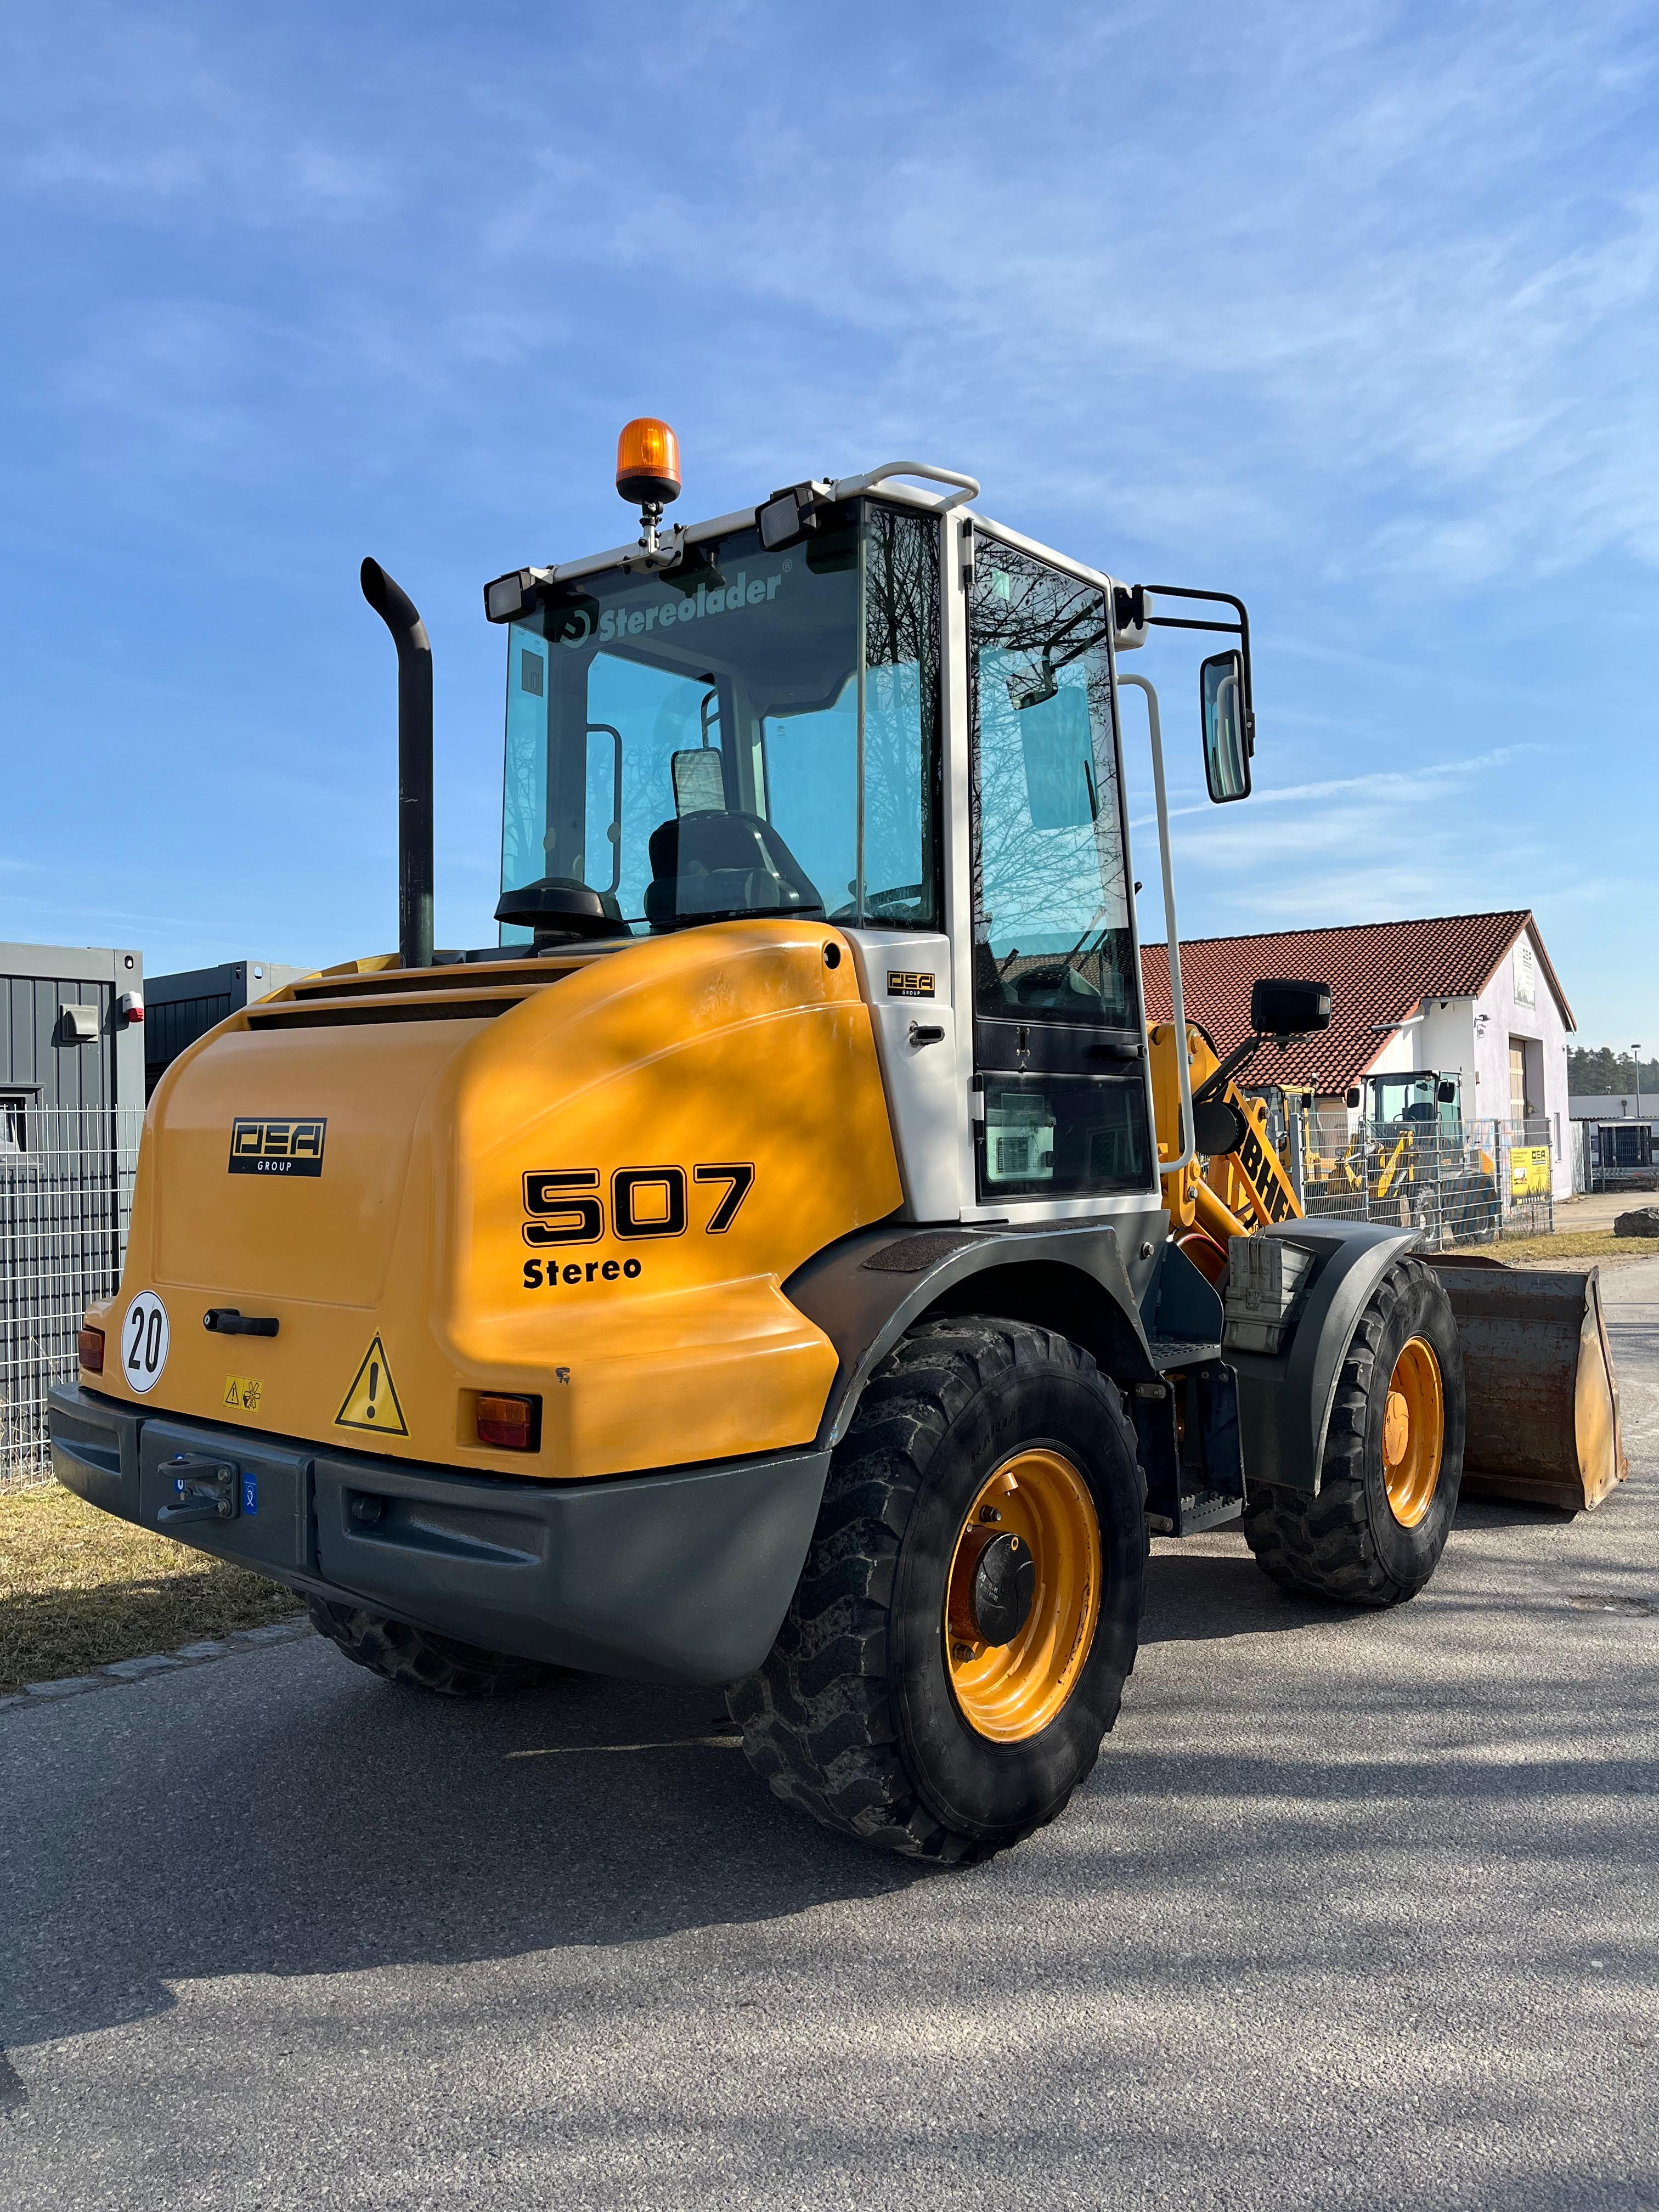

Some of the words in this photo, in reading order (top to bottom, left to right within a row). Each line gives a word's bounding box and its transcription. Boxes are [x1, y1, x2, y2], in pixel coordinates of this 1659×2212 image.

[257, 1161, 292, 1171] GROUP
[522, 1162, 755, 1248] 507
[523, 1259, 641, 1289] Stereo
[128, 1306, 162, 1373] 20
